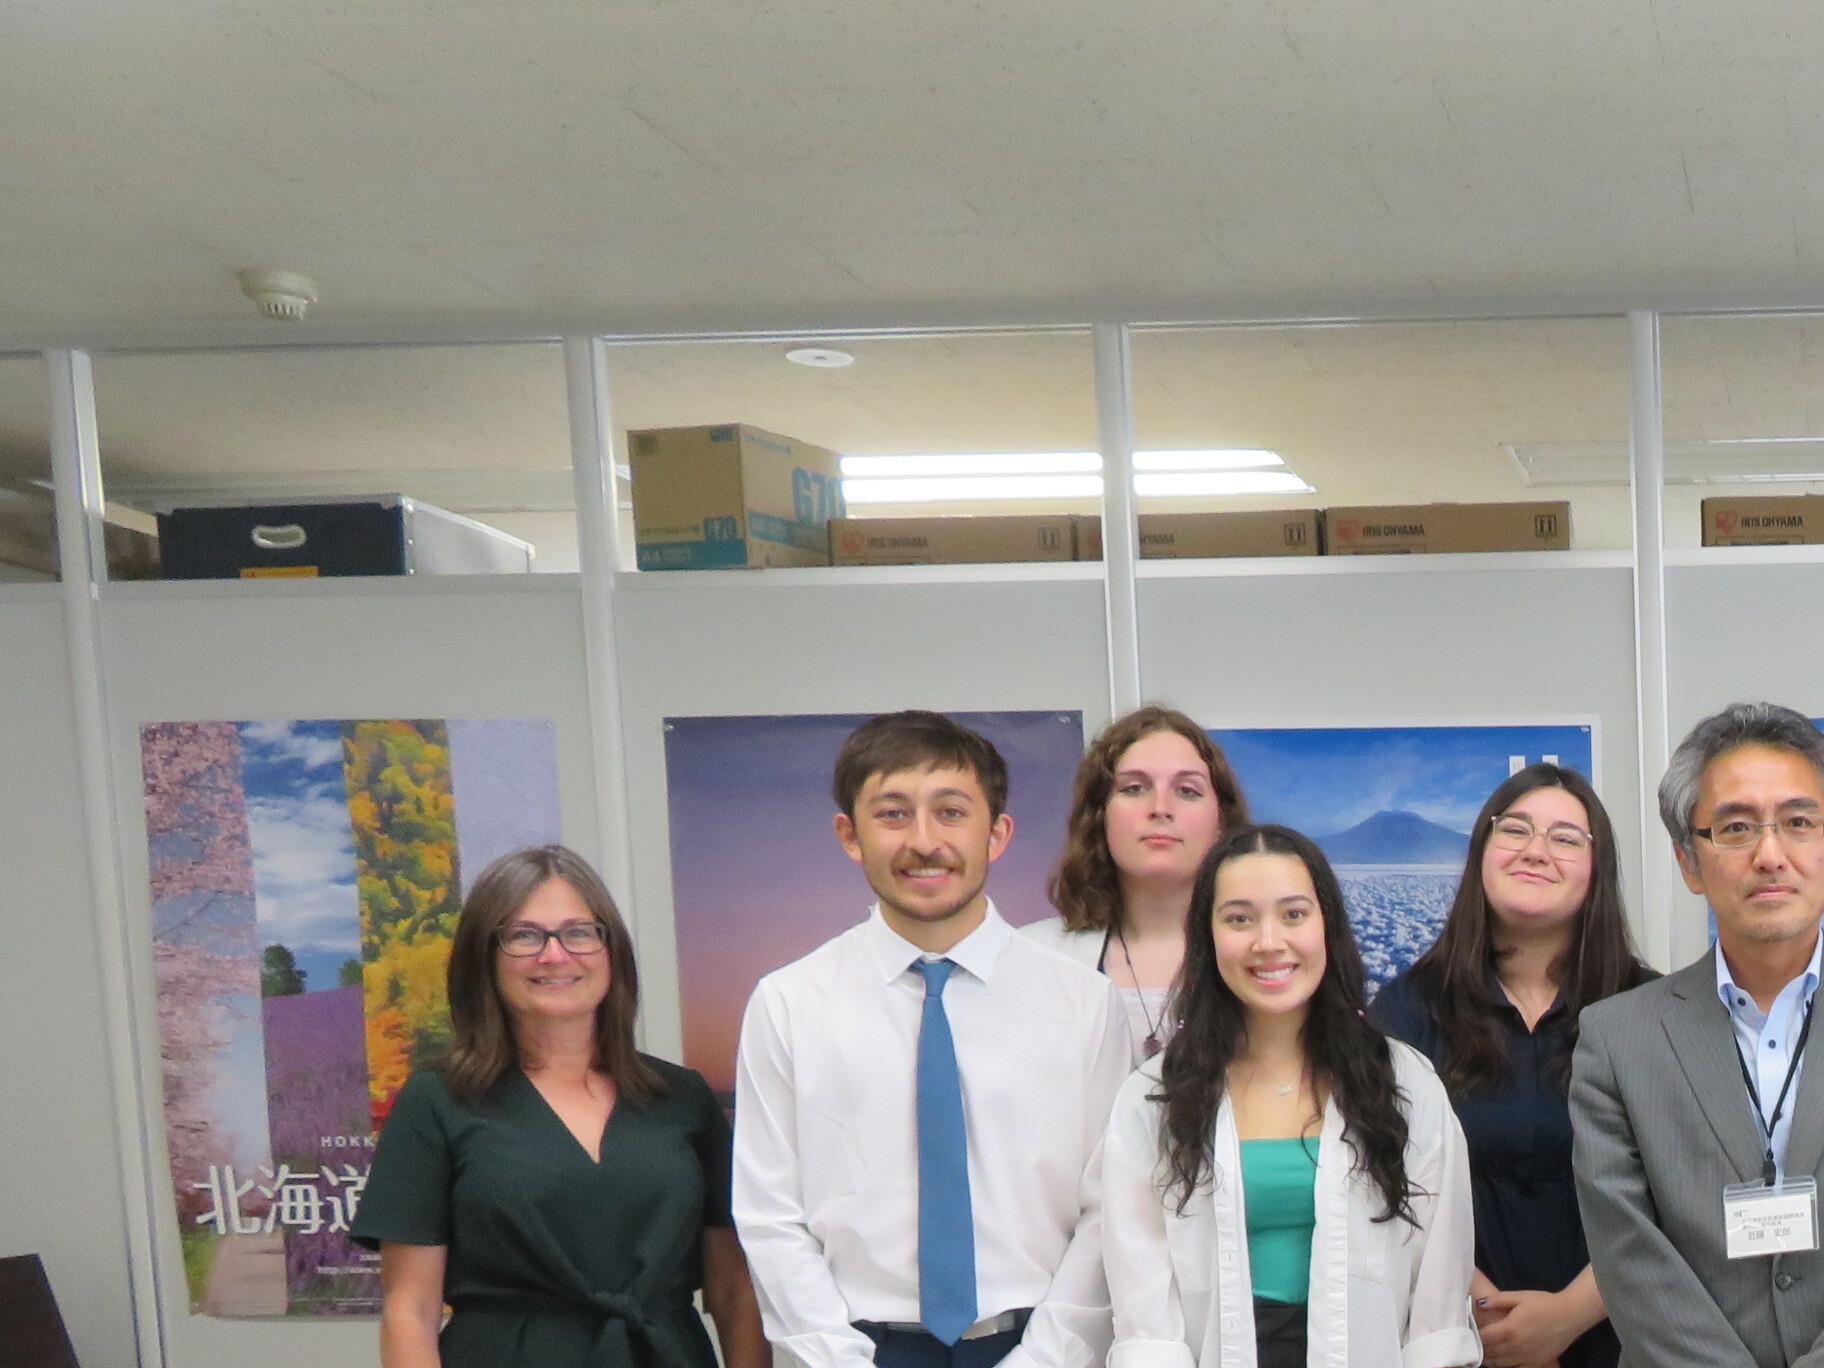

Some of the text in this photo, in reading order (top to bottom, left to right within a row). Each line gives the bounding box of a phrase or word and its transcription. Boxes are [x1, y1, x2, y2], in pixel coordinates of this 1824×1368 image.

[1741, 515, 1804, 528] IRIS OHYAMA
[1362, 523, 1425, 537] IRIS OHYAMA
[1140, 533, 1175, 544] HYAMA
